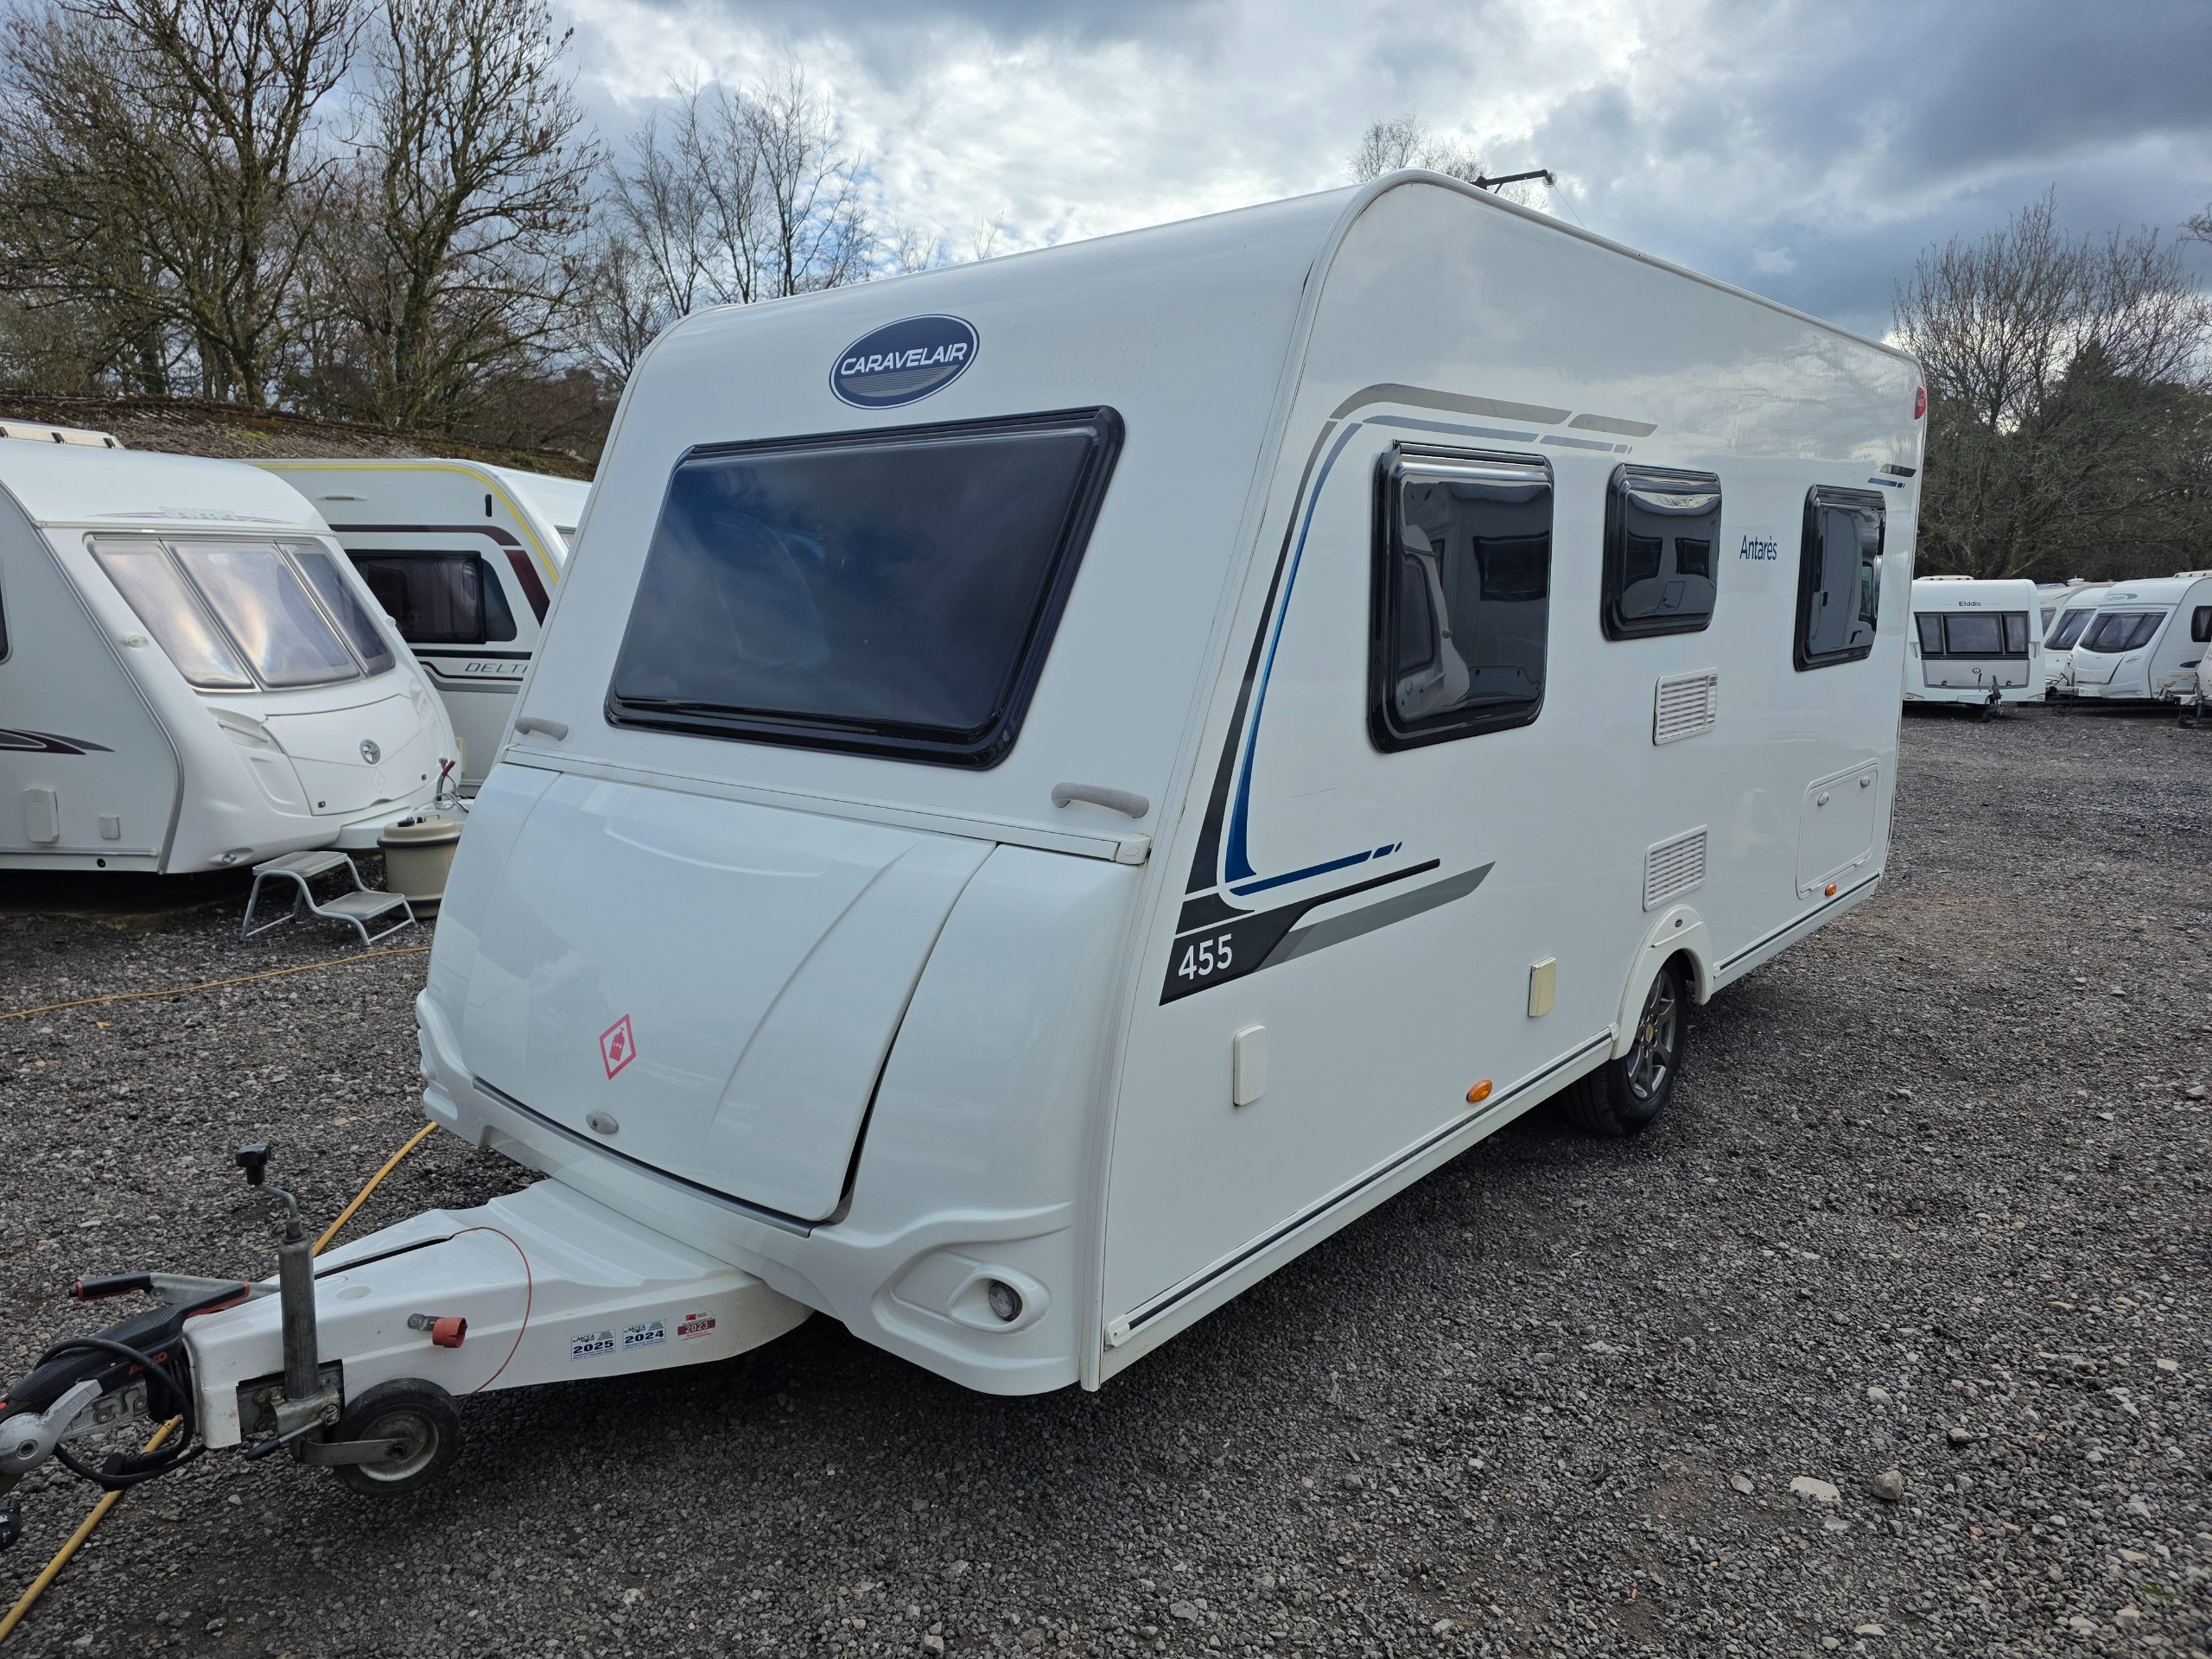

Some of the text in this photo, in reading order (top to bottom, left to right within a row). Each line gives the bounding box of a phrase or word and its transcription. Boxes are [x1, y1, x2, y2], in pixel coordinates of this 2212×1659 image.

[841, 343, 967, 375] CARAVELAIR
[1739, 535, 1777, 561] Antarès
[1178, 933, 1233, 981] 455
[625, 1330, 664, 1344] 2024
[685, 1321, 709, 1333] 2023
[573, 1339, 614, 1355] 2025
